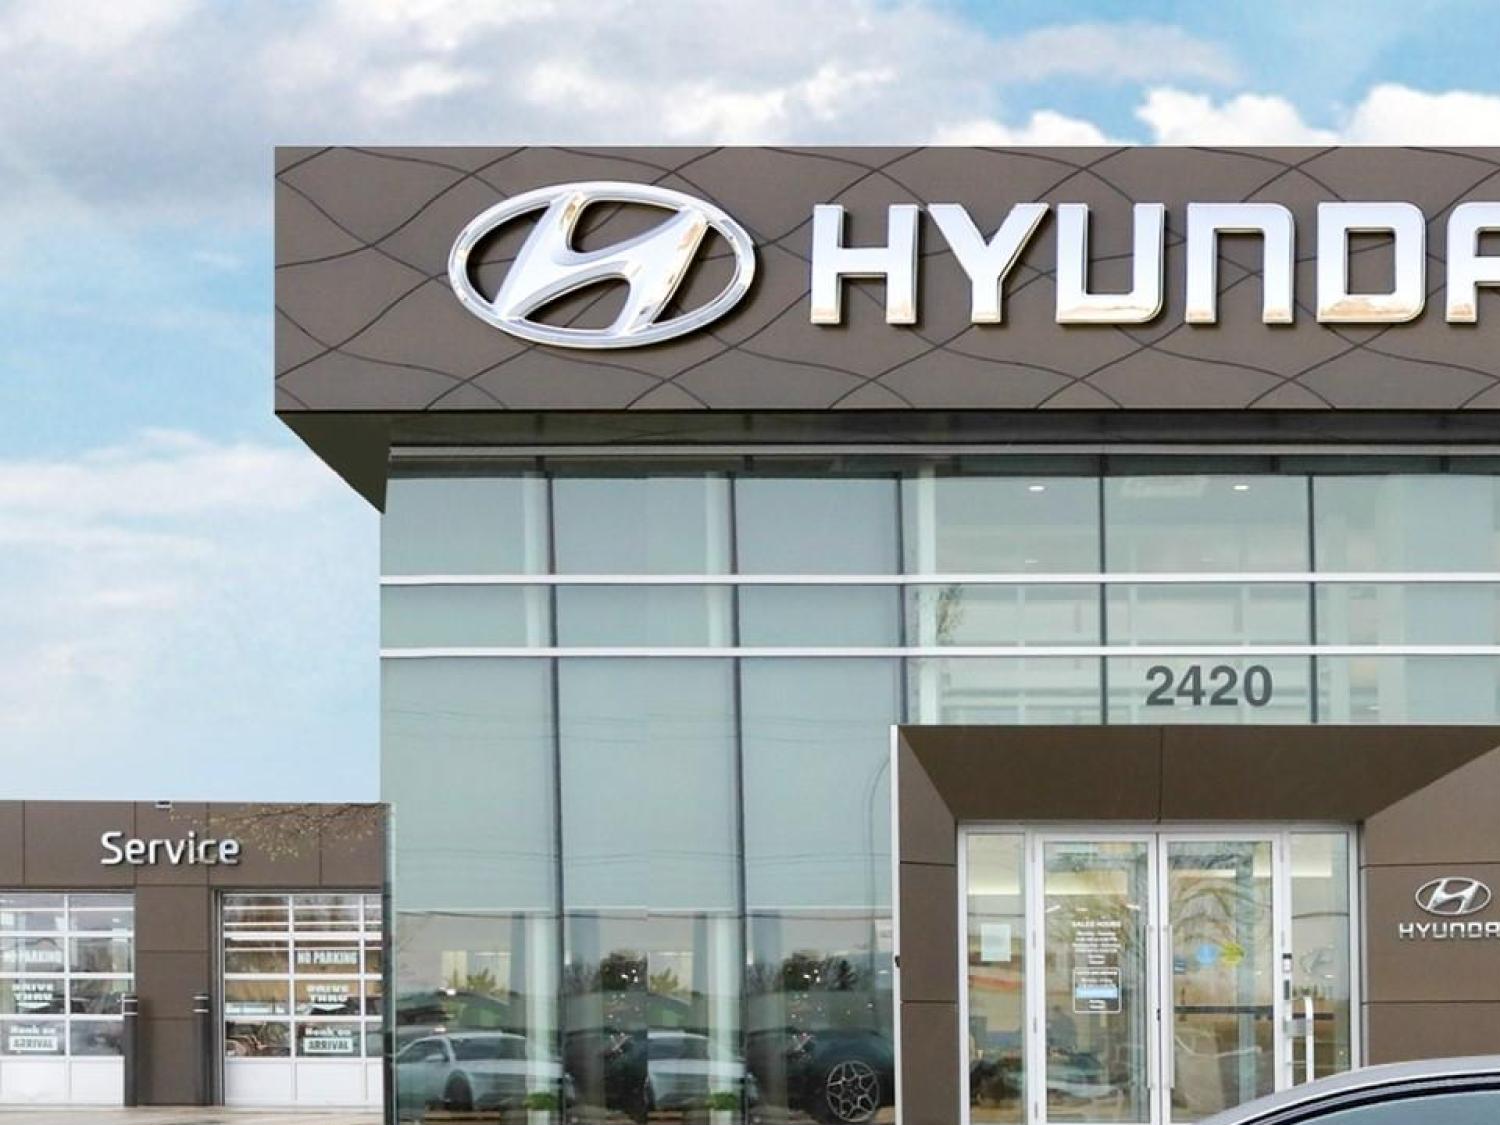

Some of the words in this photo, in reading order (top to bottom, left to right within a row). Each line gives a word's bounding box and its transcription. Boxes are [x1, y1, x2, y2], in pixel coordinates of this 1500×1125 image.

[1146, 665, 1273, 707] 2420
[101, 831, 240, 864] Service
[308, 1040, 349, 1051] ARRIVAL
